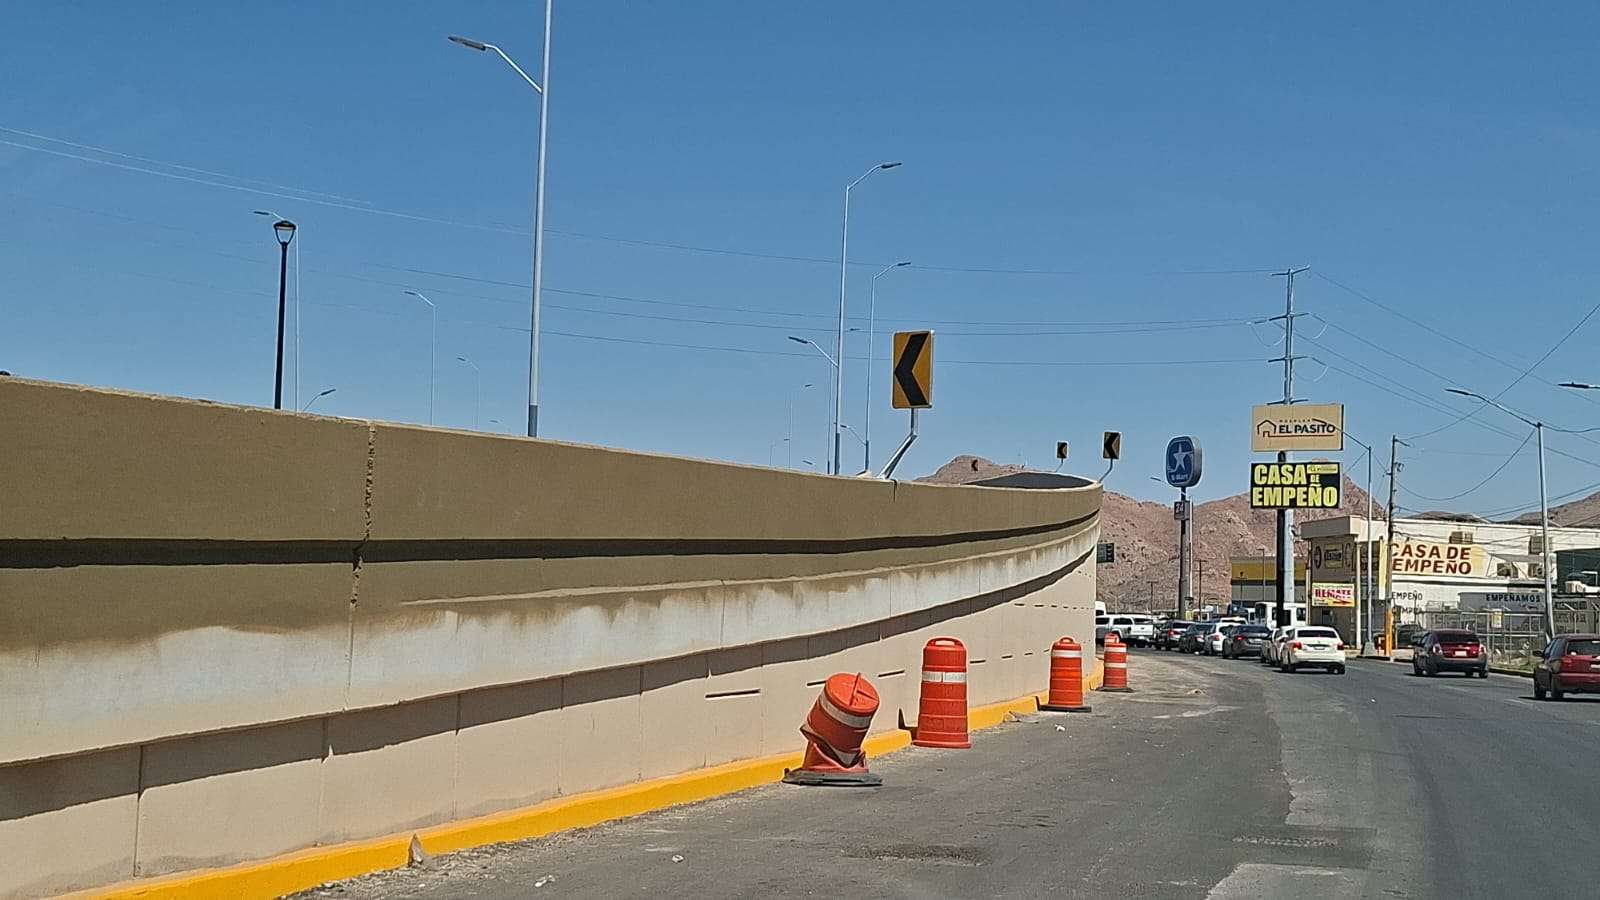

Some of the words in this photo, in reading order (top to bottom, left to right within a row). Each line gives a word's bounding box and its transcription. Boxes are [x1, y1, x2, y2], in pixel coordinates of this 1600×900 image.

[1279, 424, 1292, 433] EL
[1294, 424, 1336, 433] PASITO
[1254, 464, 1307, 485] CASA
[1310, 474, 1320, 483] DE
[1252, 483, 1338, 507] EMPEÑO
[1446, 546, 1472, 560] DE
[1392, 558, 1472, 575] EMPEÑO
